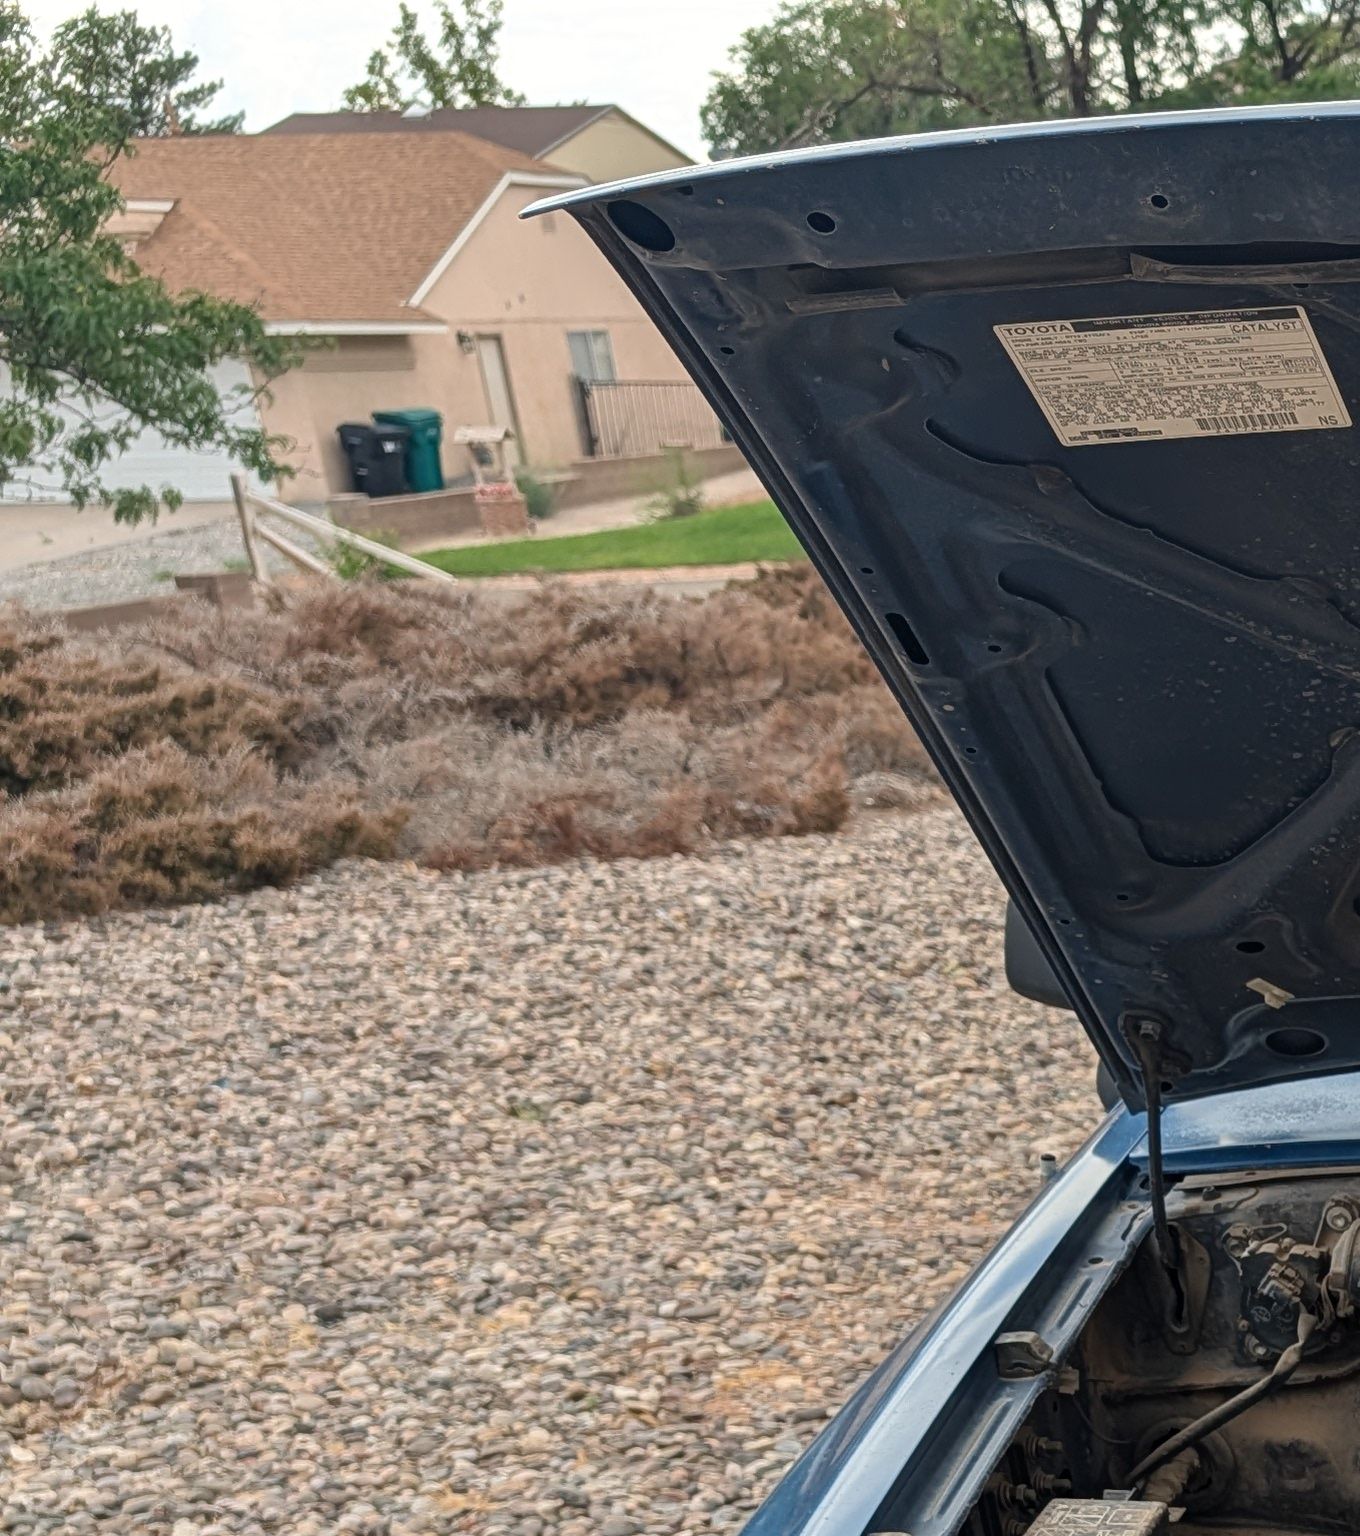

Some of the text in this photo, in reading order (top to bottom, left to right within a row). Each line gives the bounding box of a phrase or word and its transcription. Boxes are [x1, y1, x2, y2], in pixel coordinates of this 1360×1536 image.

[1199, 310, 1259, 321] INFORMATION
[1003, 323, 1071, 336] TOYOTA
[1232, 321, 1297, 334] CATALYST
[1318, 415, 1339, 426] NS
